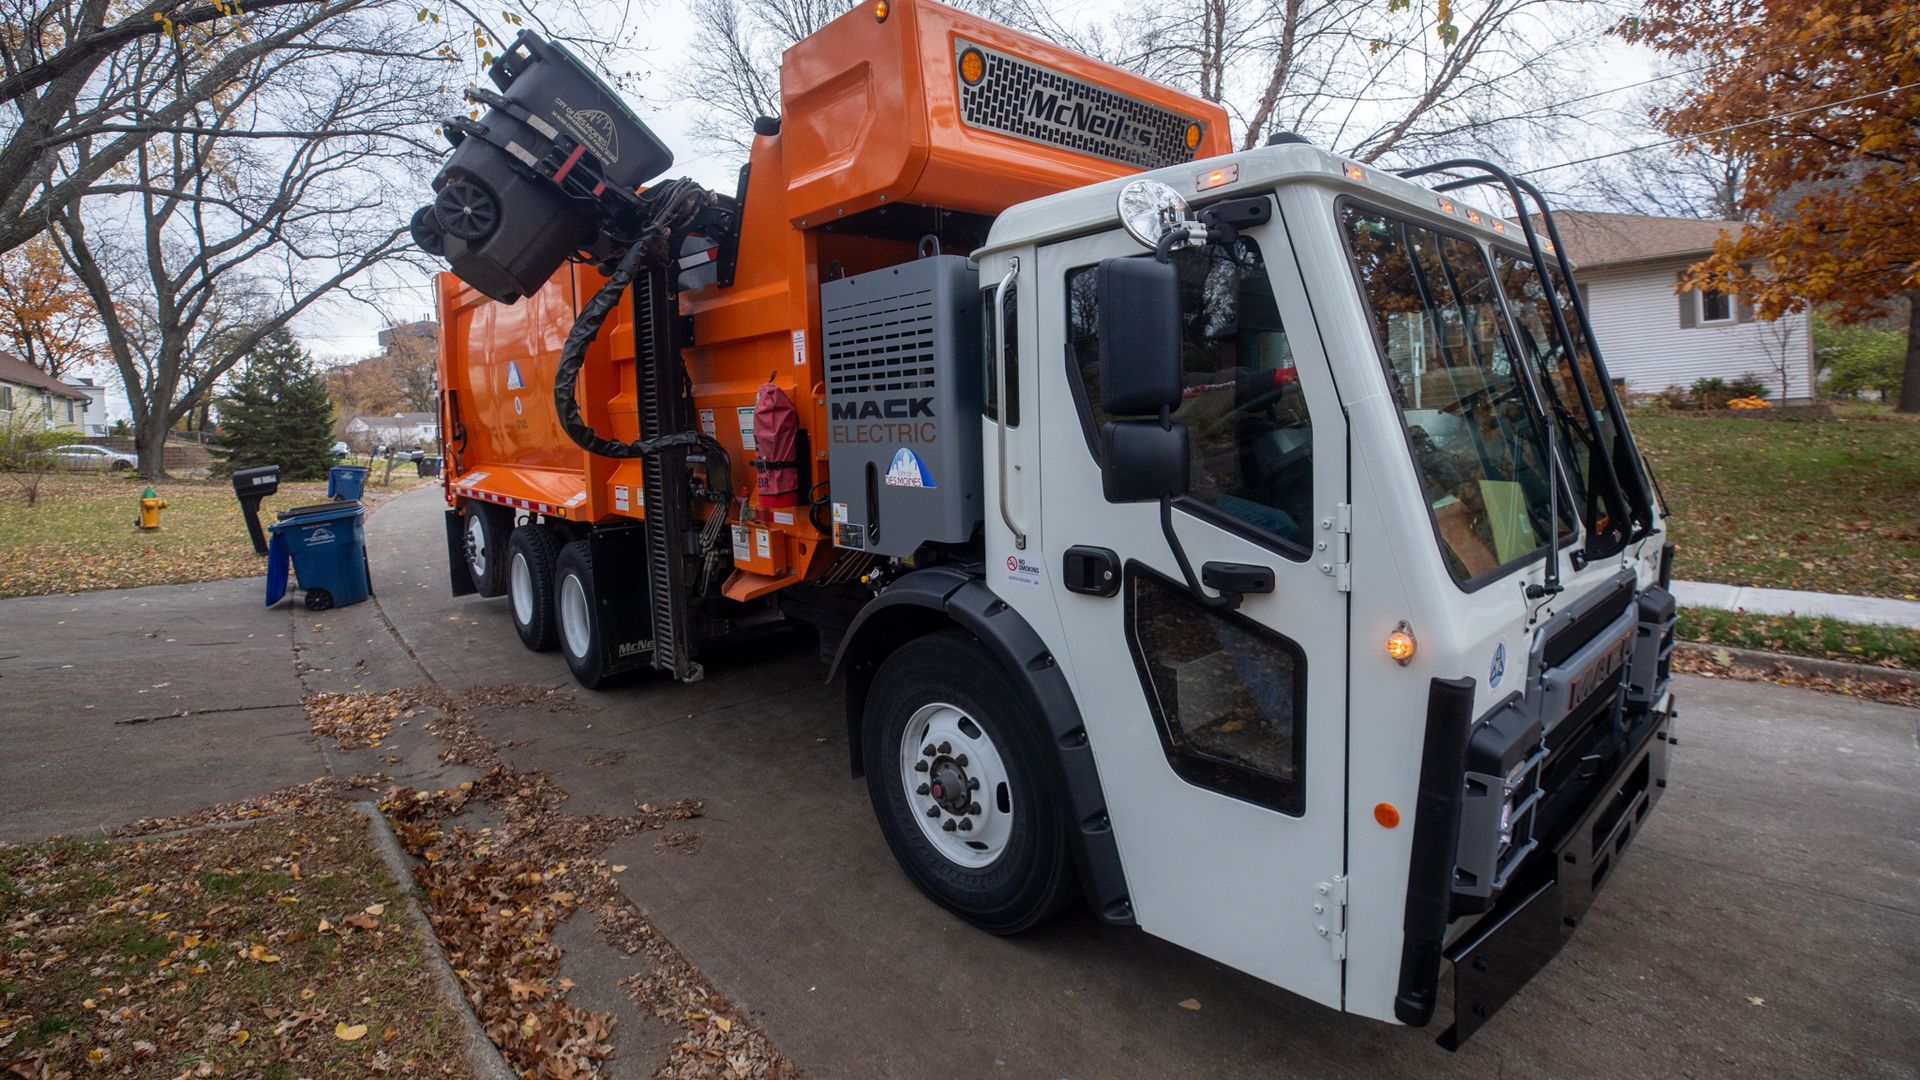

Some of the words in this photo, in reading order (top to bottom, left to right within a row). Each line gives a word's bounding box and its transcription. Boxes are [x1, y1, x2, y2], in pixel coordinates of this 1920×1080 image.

[555, 98, 567, 109] CITY
[566, 107, 575, 115] OF
[573, 112, 587, 125] DES
[585, 124, 607, 147] MOINES
[1027, 89, 1153, 147] McNeilus
[832, 397, 936, 420] MACK
[832, 422, 937, 444] ELECTRIC
[885, 476, 896, 486] DES
[897, 477, 921, 487] MOINES
[1018, 558, 1026, 566] NO
[1018, 564, 1040, 574] SMOKING
